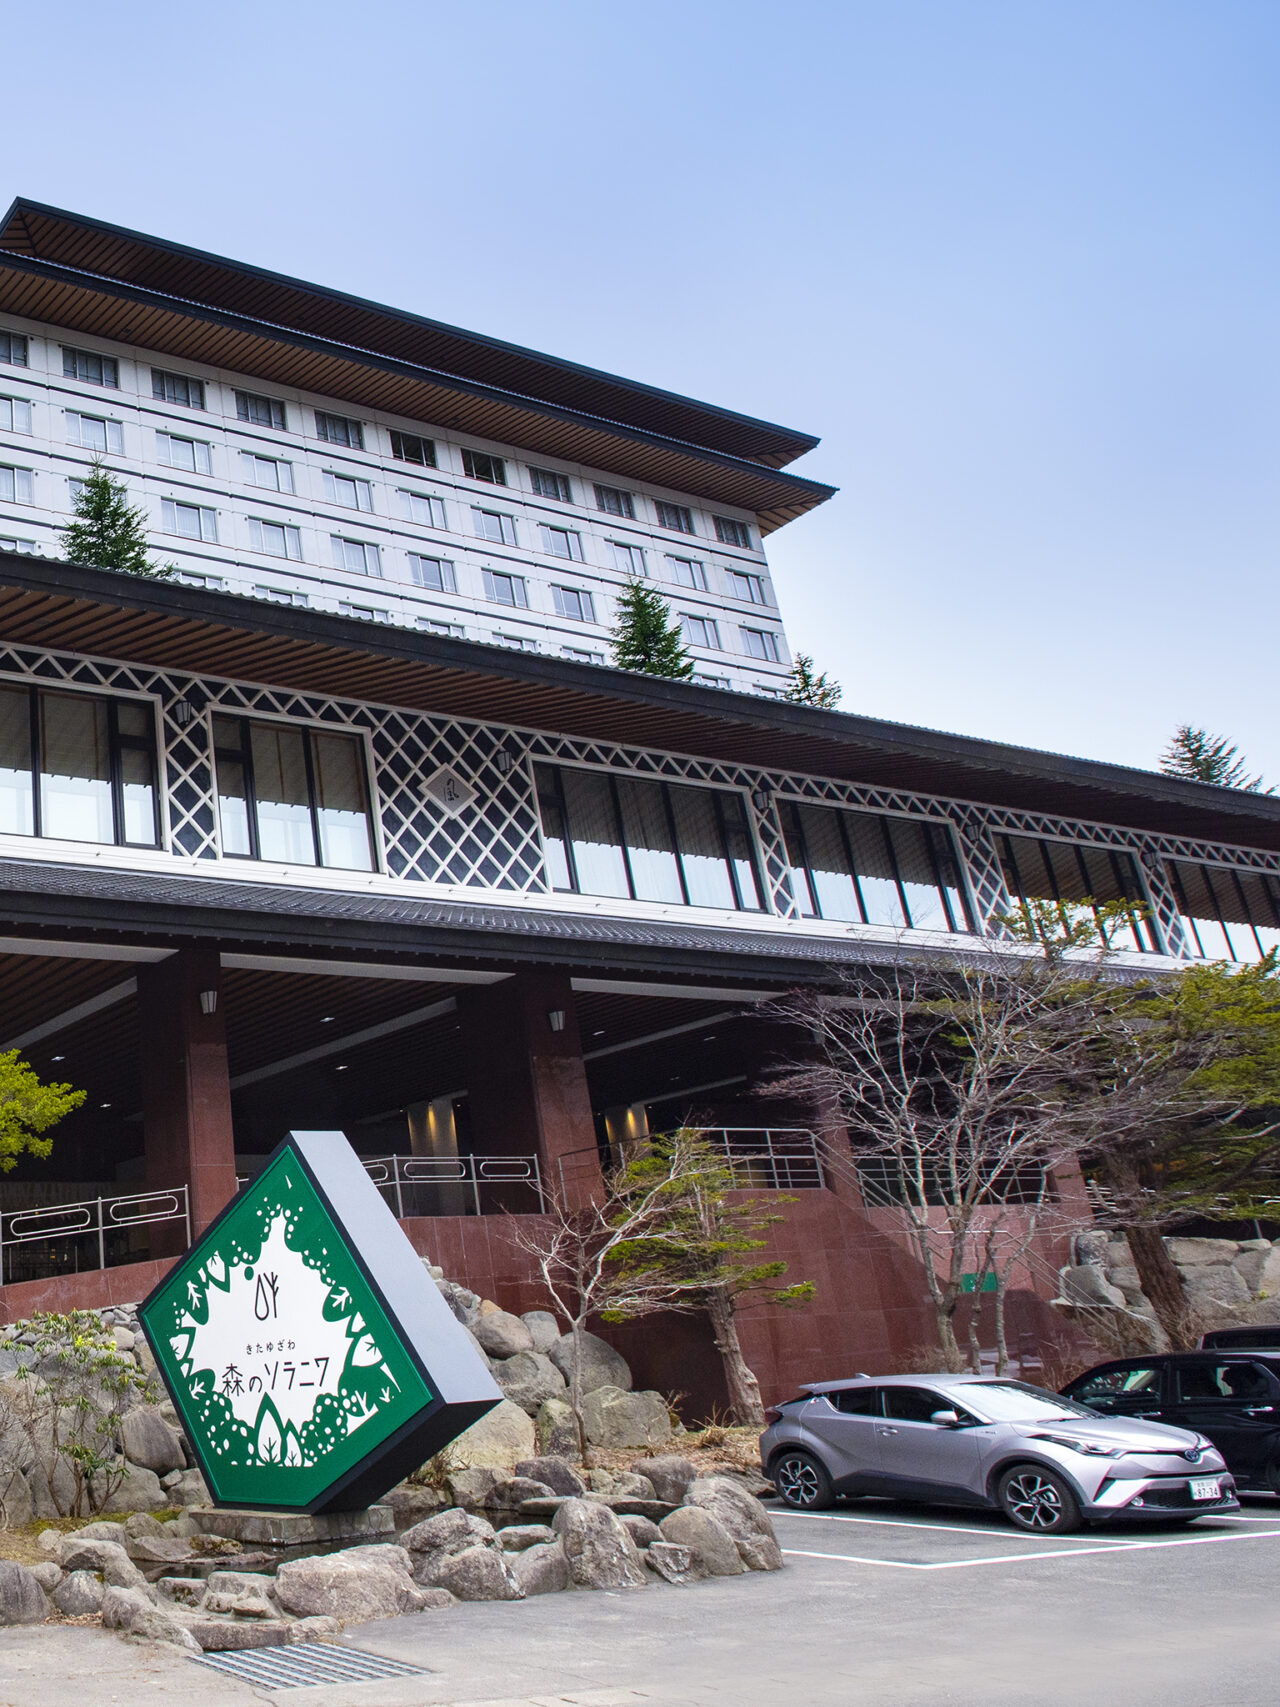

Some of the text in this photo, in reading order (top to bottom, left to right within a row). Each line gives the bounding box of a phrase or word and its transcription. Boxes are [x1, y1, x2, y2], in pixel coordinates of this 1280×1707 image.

[246, 1339, 296, 1355] きたゆざわ
[222, 1357, 329, 1397] 森のソラニワ
